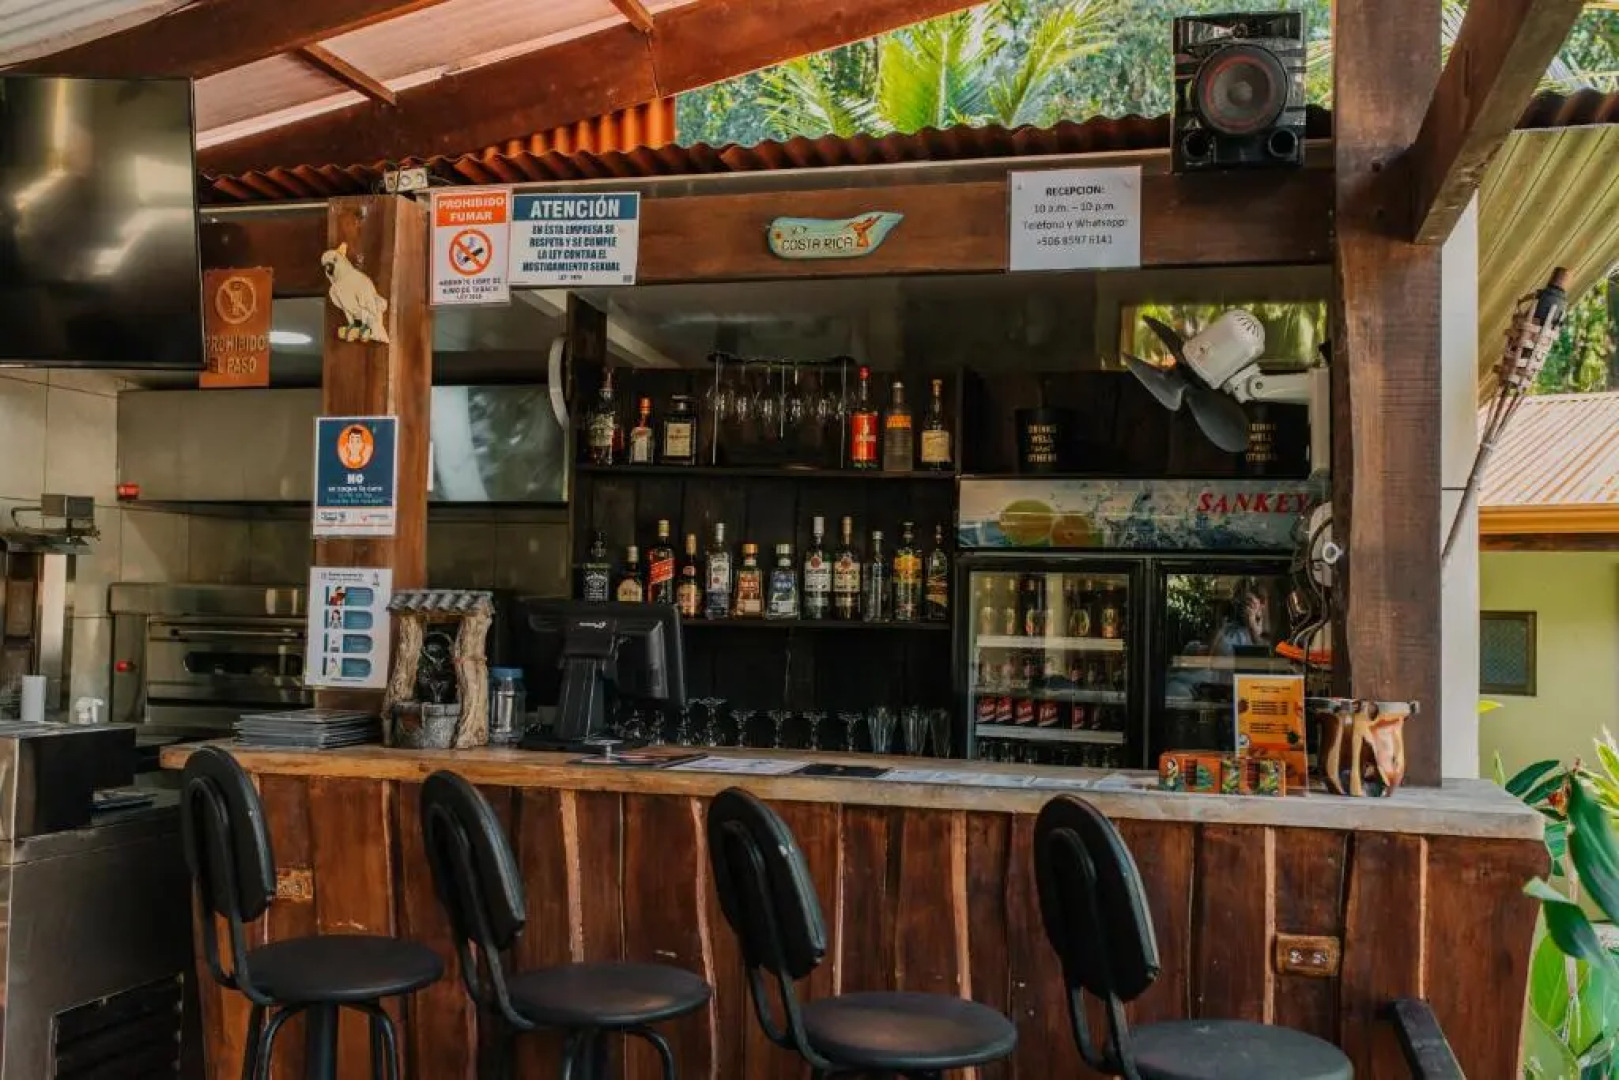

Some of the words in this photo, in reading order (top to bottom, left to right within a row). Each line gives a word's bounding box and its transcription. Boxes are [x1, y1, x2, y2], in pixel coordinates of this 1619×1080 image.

[1045, 185, 1105, 197] RECEPCION:
[439, 197, 505, 209] PROHIBIDO
[530, 193, 620, 218] ATENCIÓN
[1033, 204, 1046, 213] 10
[1080, 202, 1092, 211] 10
[450, 211, 493, 222] FUMAR
[532, 224, 543, 234] EN
[565, 225, 603, 234] EMPRESA
[605, 224, 615, 234] SE
[1067, 221, 1073, 230] y
[529, 237, 564, 247] RESPETA
[565, 237, 570, 247] Y
[571, 237, 582, 247] SE
[584, 236, 618, 247] CUMPLE
[781, 239, 821, 251] COSTA
[823, 237, 854, 250] RICA
[537, 249, 547, 259] LA
[549, 249, 562, 259] LEY
[564, 249, 597, 259] CONTRA
[598, 249, 608, 259] EL
[522, 262, 589, 272] HOSTIGAMIENTO
[589, 261, 620, 272] SEXUAL
[204, 334, 265, 352] PROHIBIDO
[227, 356, 257, 374] PASO
[347, 473, 365, 485] NO
[1196, 492, 1308, 514] SANKEY
